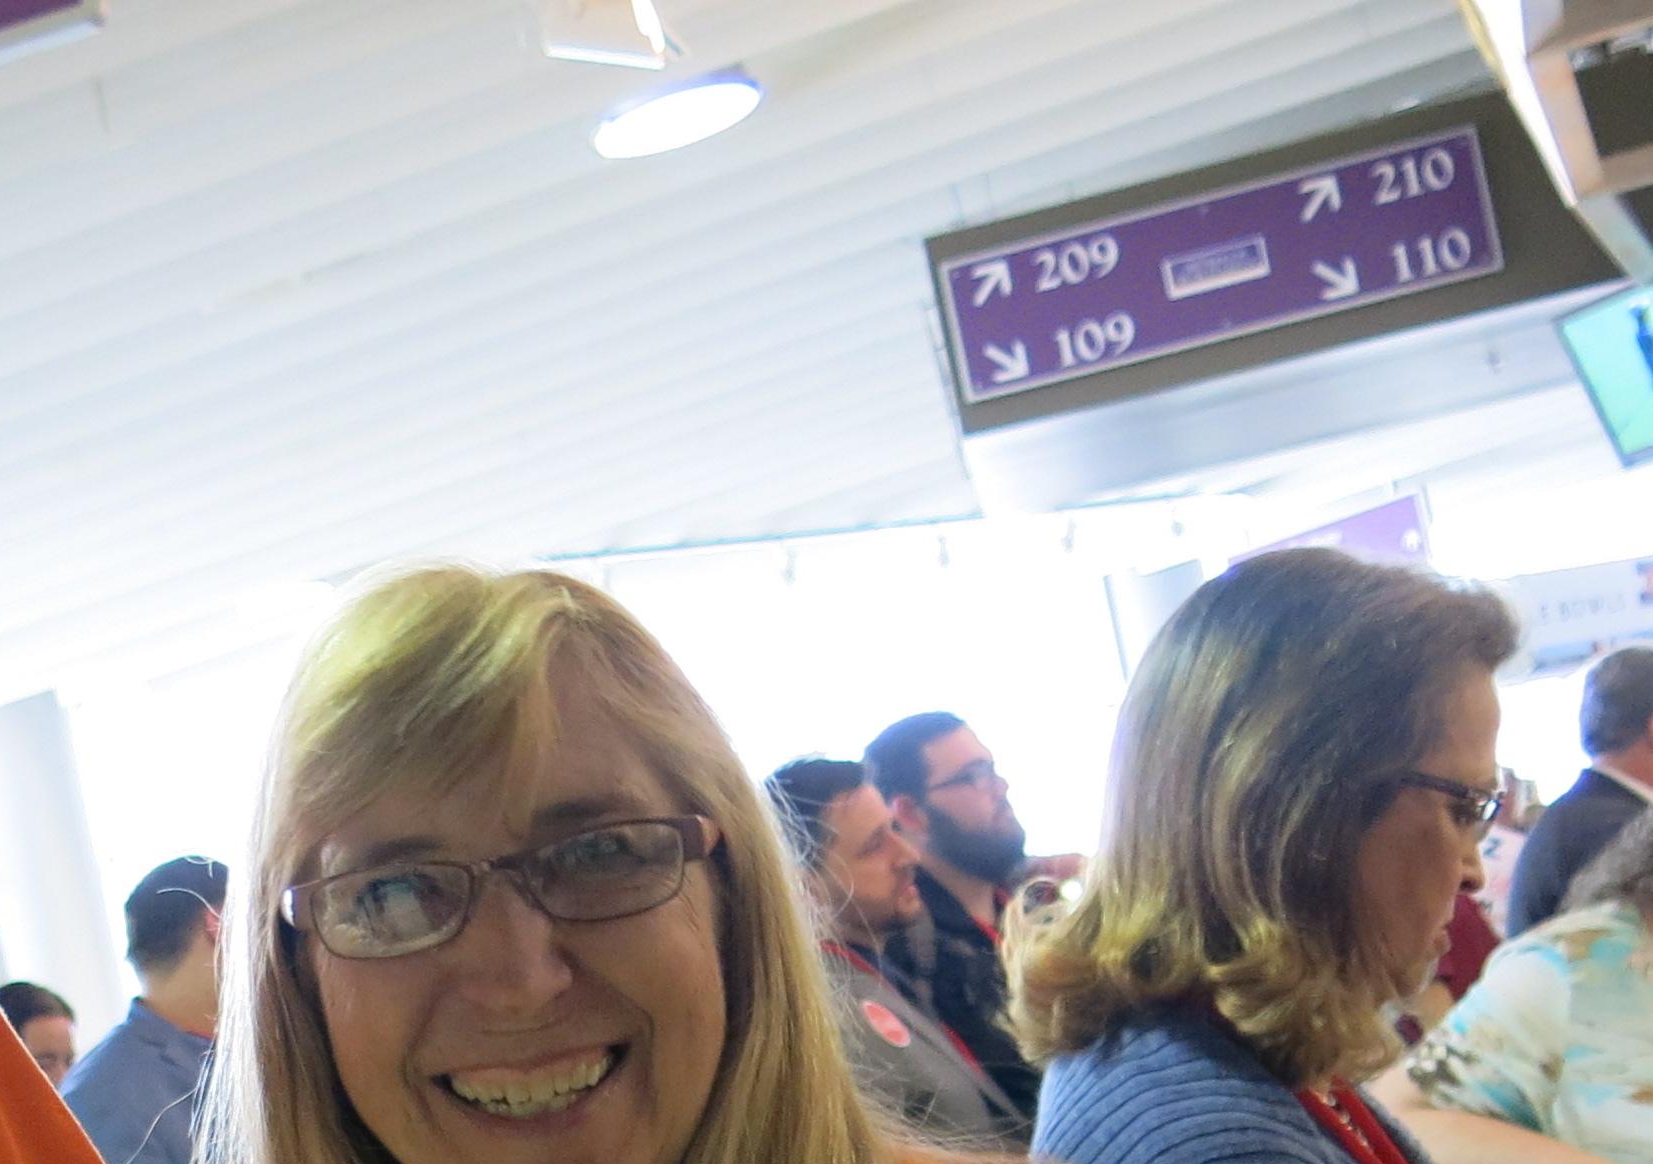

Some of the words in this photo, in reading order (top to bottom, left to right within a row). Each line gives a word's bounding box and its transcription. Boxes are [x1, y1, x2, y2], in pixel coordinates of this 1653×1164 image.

[1372, 147, 1456, 206] 210
[1032, 235, 1122, 292] 209
[1388, 228, 1473, 285] 110
[1053, 312, 1136, 368] 109
